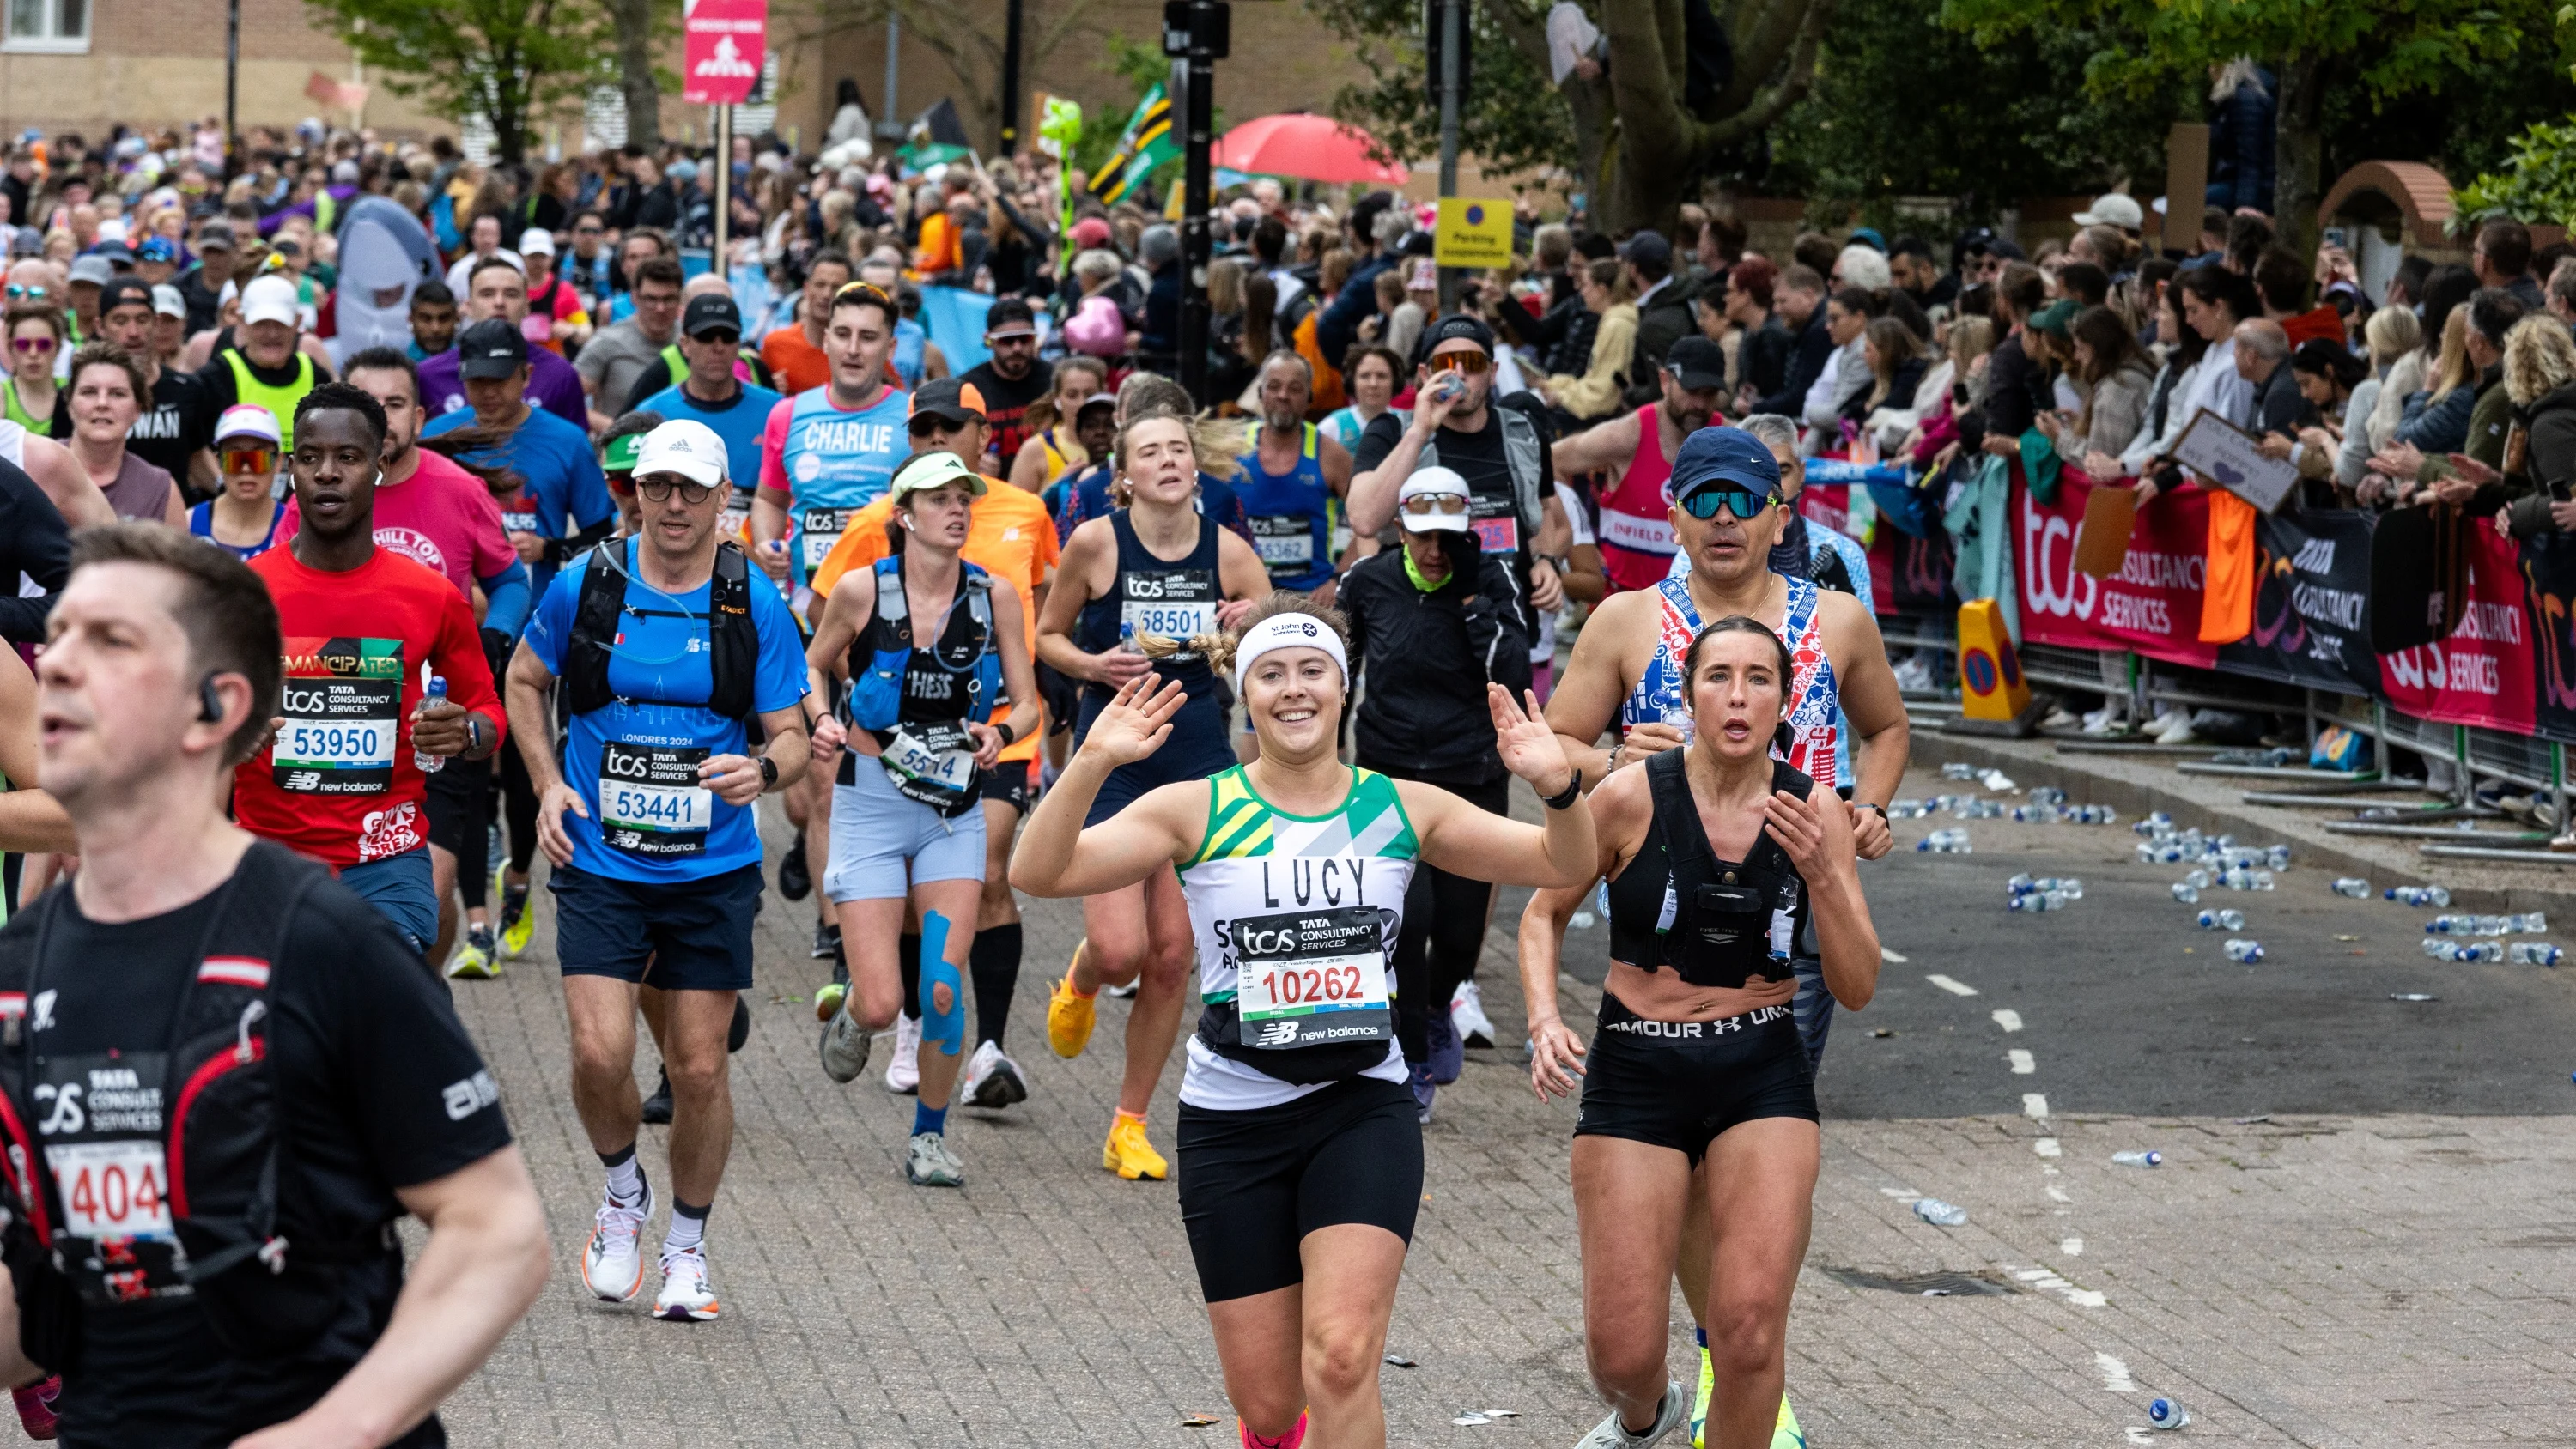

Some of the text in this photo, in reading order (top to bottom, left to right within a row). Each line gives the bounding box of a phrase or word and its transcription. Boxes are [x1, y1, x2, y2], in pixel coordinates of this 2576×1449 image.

[804, 422, 893, 453] CHARLIE
[805, 512, 833, 531] tcs
[1614, 522, 1663, 542] ENFIELD
[1474, 525, 1504, 546] 25
[373, 531, 408, 545] HILL
[412, 534, 441, 565] TOP
[2108, 550, 2208, 591] SULTANCY
[1127, 576, 1163, 597] tcs
[2100, 591, 2171, 634] SERVICES
[2450, 601, 2522, 645] SULTANCY
[2450, 652, 2500, 696] SERVICES
[908, 670, 954, 700] HESS
[283, 685, 325, 713] tcs
[328, 695, 390, 704] CONSULTANCY
[329, 705, 368, 713] SERVICES
[622, 733, 693, 745] LONDRES 2024
[927, 726, 949, 735] TATA
[294, 728, 377, 756] 53950
[608, 748, 677, 778] tcs TATA
[651, 762, 701, 772] CONSULTANC
[650, 771, 688, 780] SERVICES
[320, 783, 343, 791] new
[343, 782, 383, 791] balance
[902, 787, 952, 807] new balance
[617, 791, 692, 822] 53441
[640, 843, 659, 852] new
[660, 843, 696, 852] balance
[1263, 858, 1364, 908] LUCY
[1243, 919, 1331, 955] tcs TATA
[1300, 925, 1372, 941] CONSULTANCY
[1300, 939, 1346, 951] SERVICES
[1262, 966, 1364, 1004] 10262
[1300, 1029, 1327, 1042] new
[1327, 1025, 1378, 1038] balance
[88, 1068, 139, 1089] TATA
[88, 1089, 163, 1111] CONSULT
[90, 1111, 163, 1131] SERVICES
[52, 1164, 159, 1225] 404
